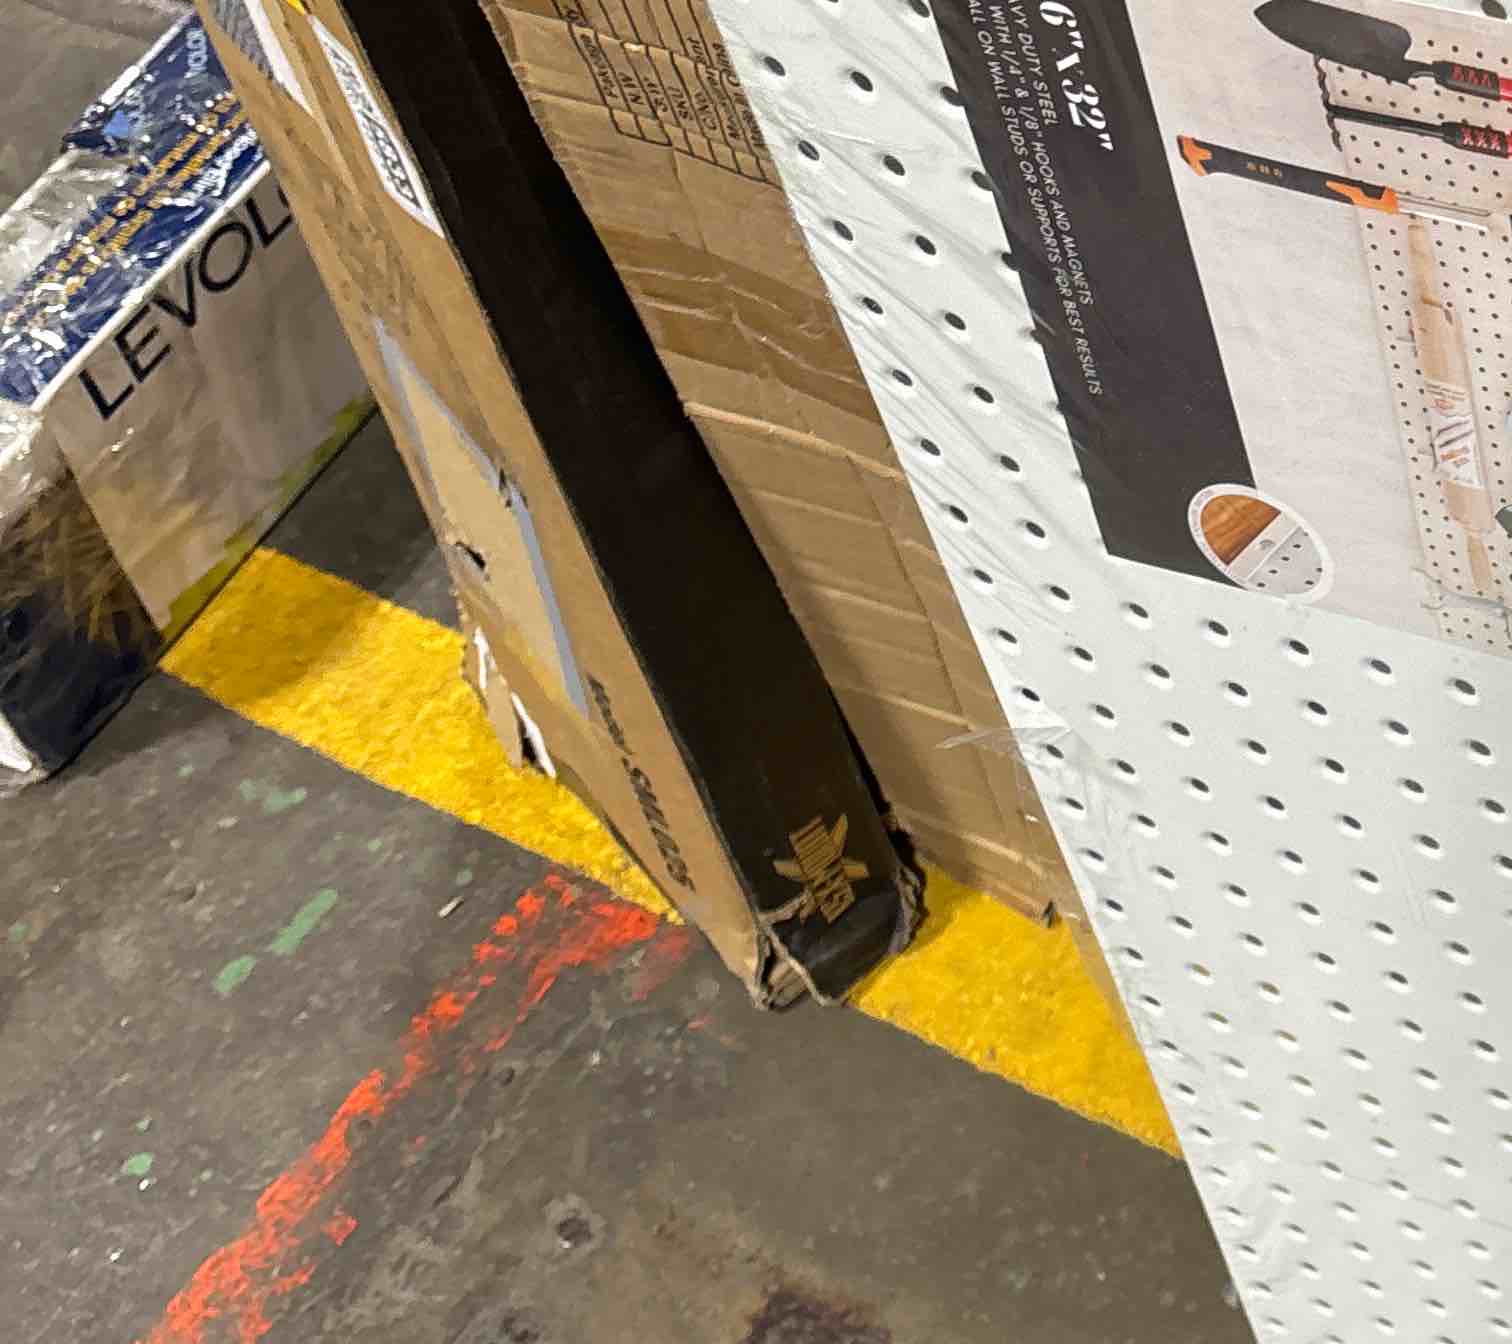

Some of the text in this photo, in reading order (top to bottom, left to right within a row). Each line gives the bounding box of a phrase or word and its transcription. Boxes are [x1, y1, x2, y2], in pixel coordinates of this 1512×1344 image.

[977, 30, 999, 57] ON
[988, 5, 1012, 45] WITH
[986, 59, 1011, 100] WALL
[1014, 87, 1030, 98] &
[1017, 32, 1045, 77] DUTY
[1032, 80, 1060, 126] STEEL
[1001, 104, 1029, 158] STUDS
[1018, 160, 1039, 184] OR
[1031, 140, 1060, 197] HOOKS
[1027, 186, 1063, 270] SUPPORTS
[1051, 200, 1072, 232] AND
[1053, 266, 1073, 298] FOR
[1061, 233, 1094, 306] MAGNETS
[78, 186, 293, 423] LEVOL
[1063, 299, 1086, 335] BEST
[1075, 336, 1103, 397] RESULTS
